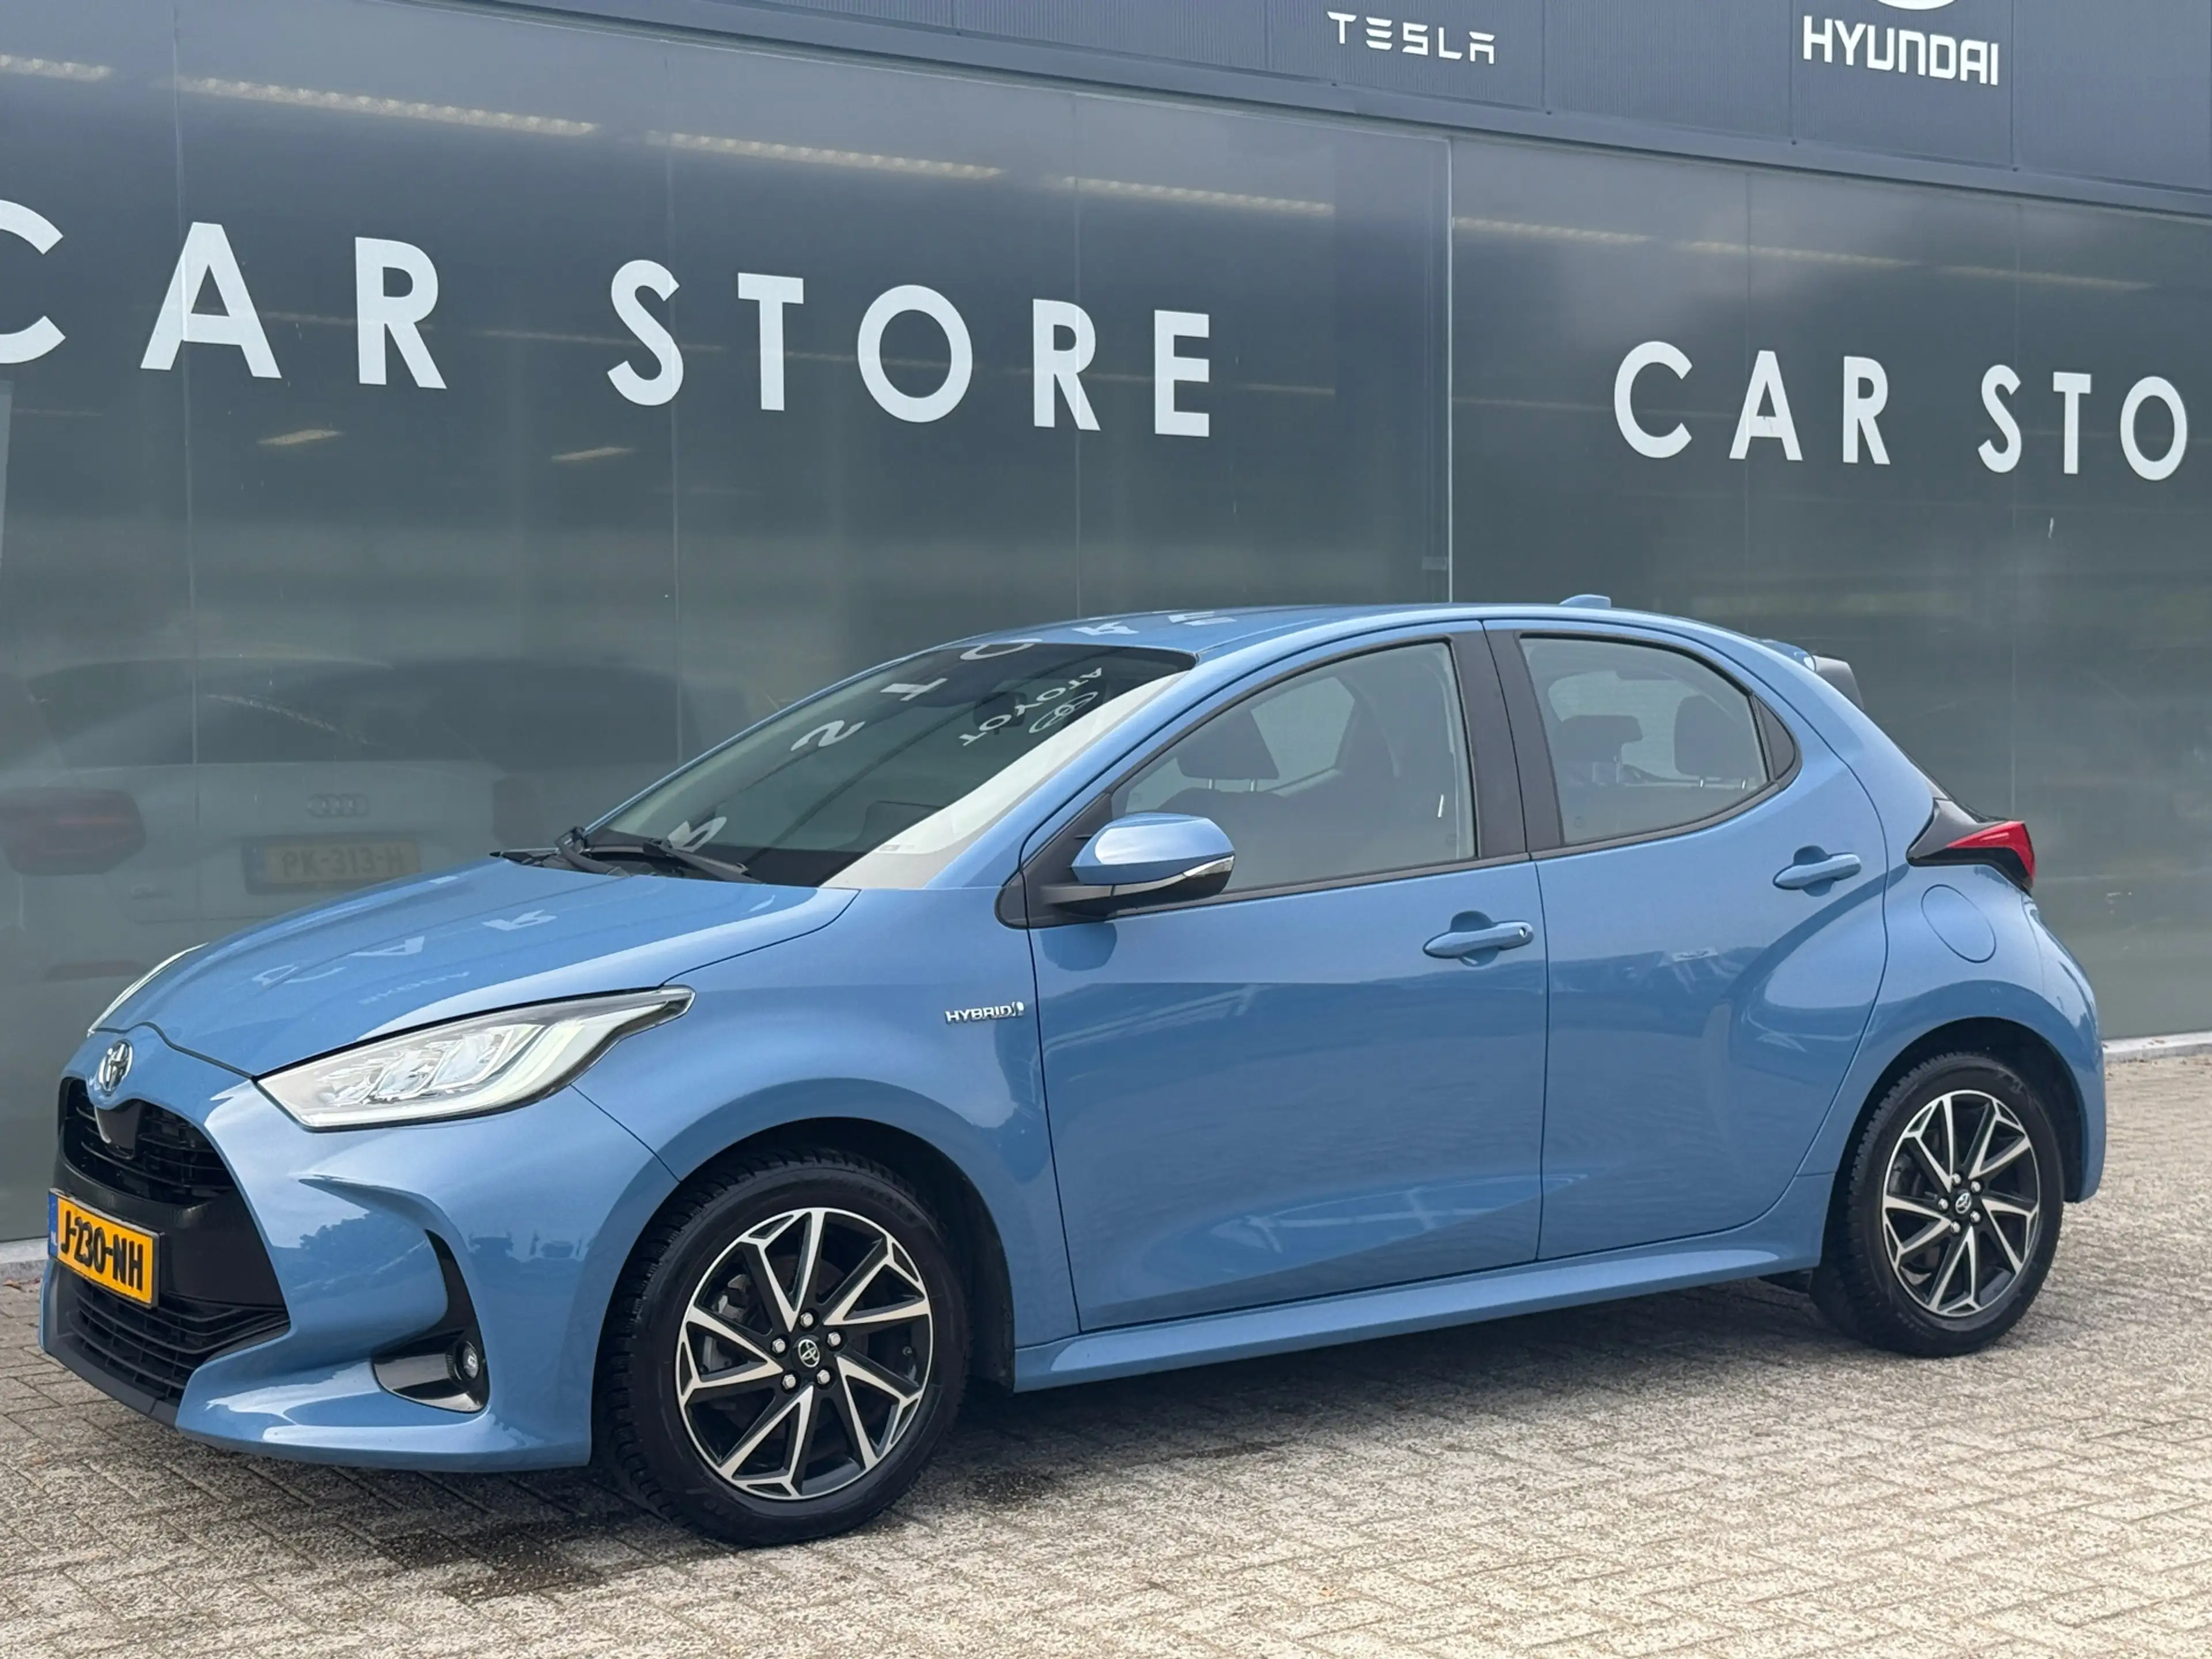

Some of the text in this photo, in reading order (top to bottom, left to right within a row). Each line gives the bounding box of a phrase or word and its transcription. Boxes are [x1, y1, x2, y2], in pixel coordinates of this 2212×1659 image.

[1327, 11, 1495, 65] TESLA
[1802, 15, 1999, 86] HYUNDAI
[607, 259, 1210, 437] STORE
[1613, 340, 2188, 481] CAR STO
[945, 1004, 1013, 1023] HYBRID
[60, 1210, 143, 1292] J-230-NH
